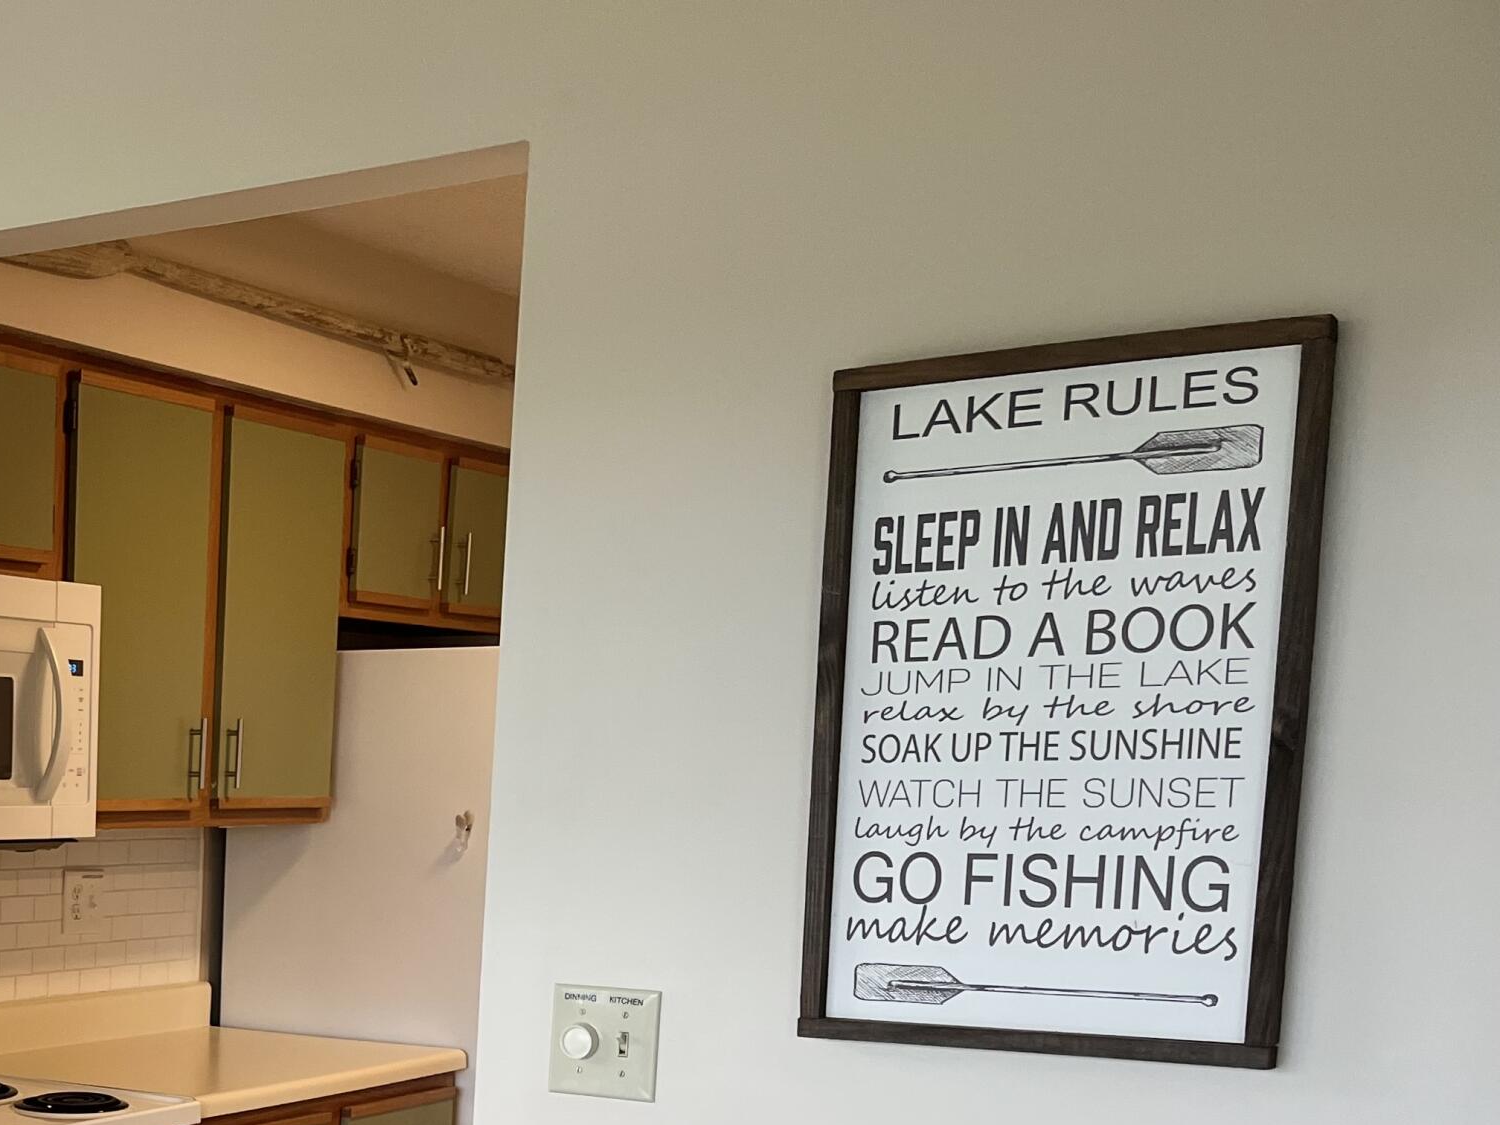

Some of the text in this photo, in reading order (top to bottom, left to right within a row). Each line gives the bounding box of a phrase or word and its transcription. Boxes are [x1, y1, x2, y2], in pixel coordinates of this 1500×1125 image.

[892, 365, 1259, 441] LAKE RULES
[872, 486, 1267, 576] SLEEP IN AND RELAX
[871, 566, 1257, 613] listen to the waves
[871, 601, 1258, 665] READ A BOOK
[860, 657, 1251, 697] JUMP IN THE LAKE
[863, 692, 1256, 727] relax by the shore
[860, 726, 1243, 764] SOAK UP THE SUNSHINE
[858, 776, 1246, 809] WATCH THE SUNSET
[854, 814, 1240, 852] laugh by the campfire
[852, 850, 1231, 913] GO FISHING
[845, 904, 1238, 962] make memories
[609, 996, 644, 1006] KITCHEN
